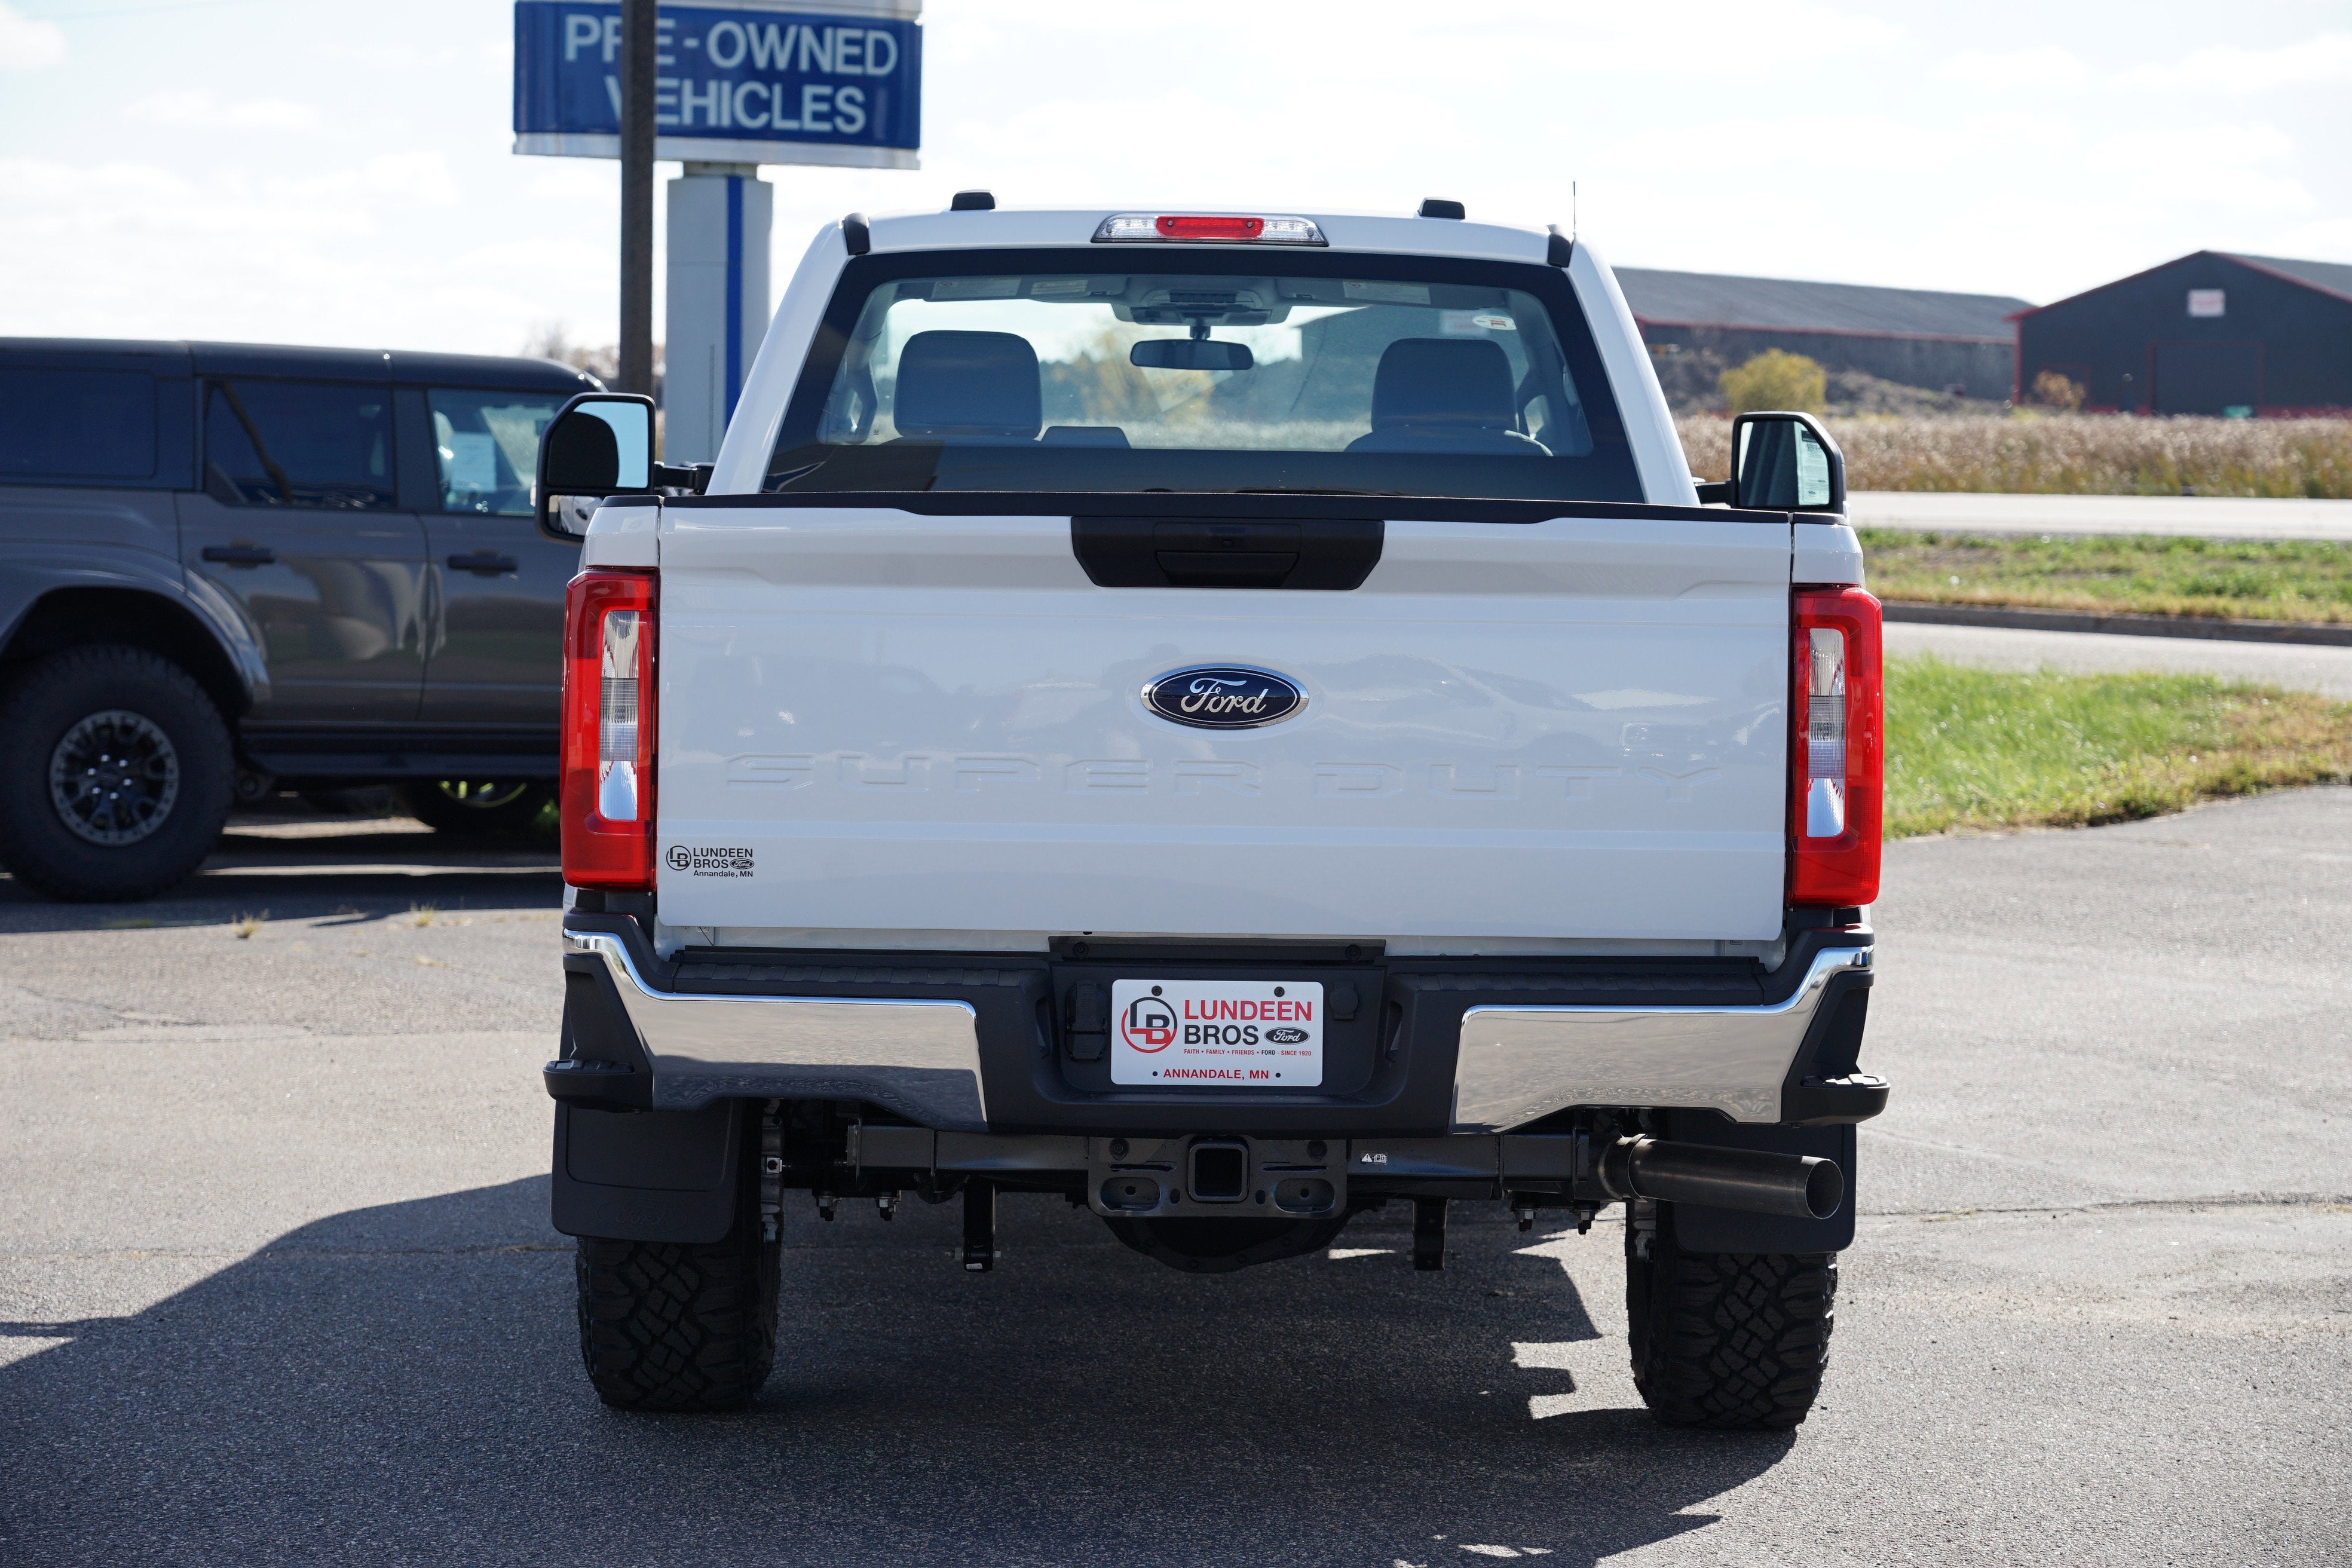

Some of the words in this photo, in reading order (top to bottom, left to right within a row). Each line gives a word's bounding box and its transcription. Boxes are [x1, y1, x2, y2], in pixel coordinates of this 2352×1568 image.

[1180, 677, 1269, 713] Ford
[726, 752, 1261, 797] SUPER
[1312, 762, 1722, 803] DUTY
[693, 847, 753, 858] LUNDEEN
[693, 859, 729, 868] BROS
[1184, 1000, 1312, 1021] LUNDEEN
[1184, 1024, 1259, 1045] BROS
[1163, 1068, 1245, 1080] ANNANDALE,
[1250, 1070, 1269, 1079] MN
